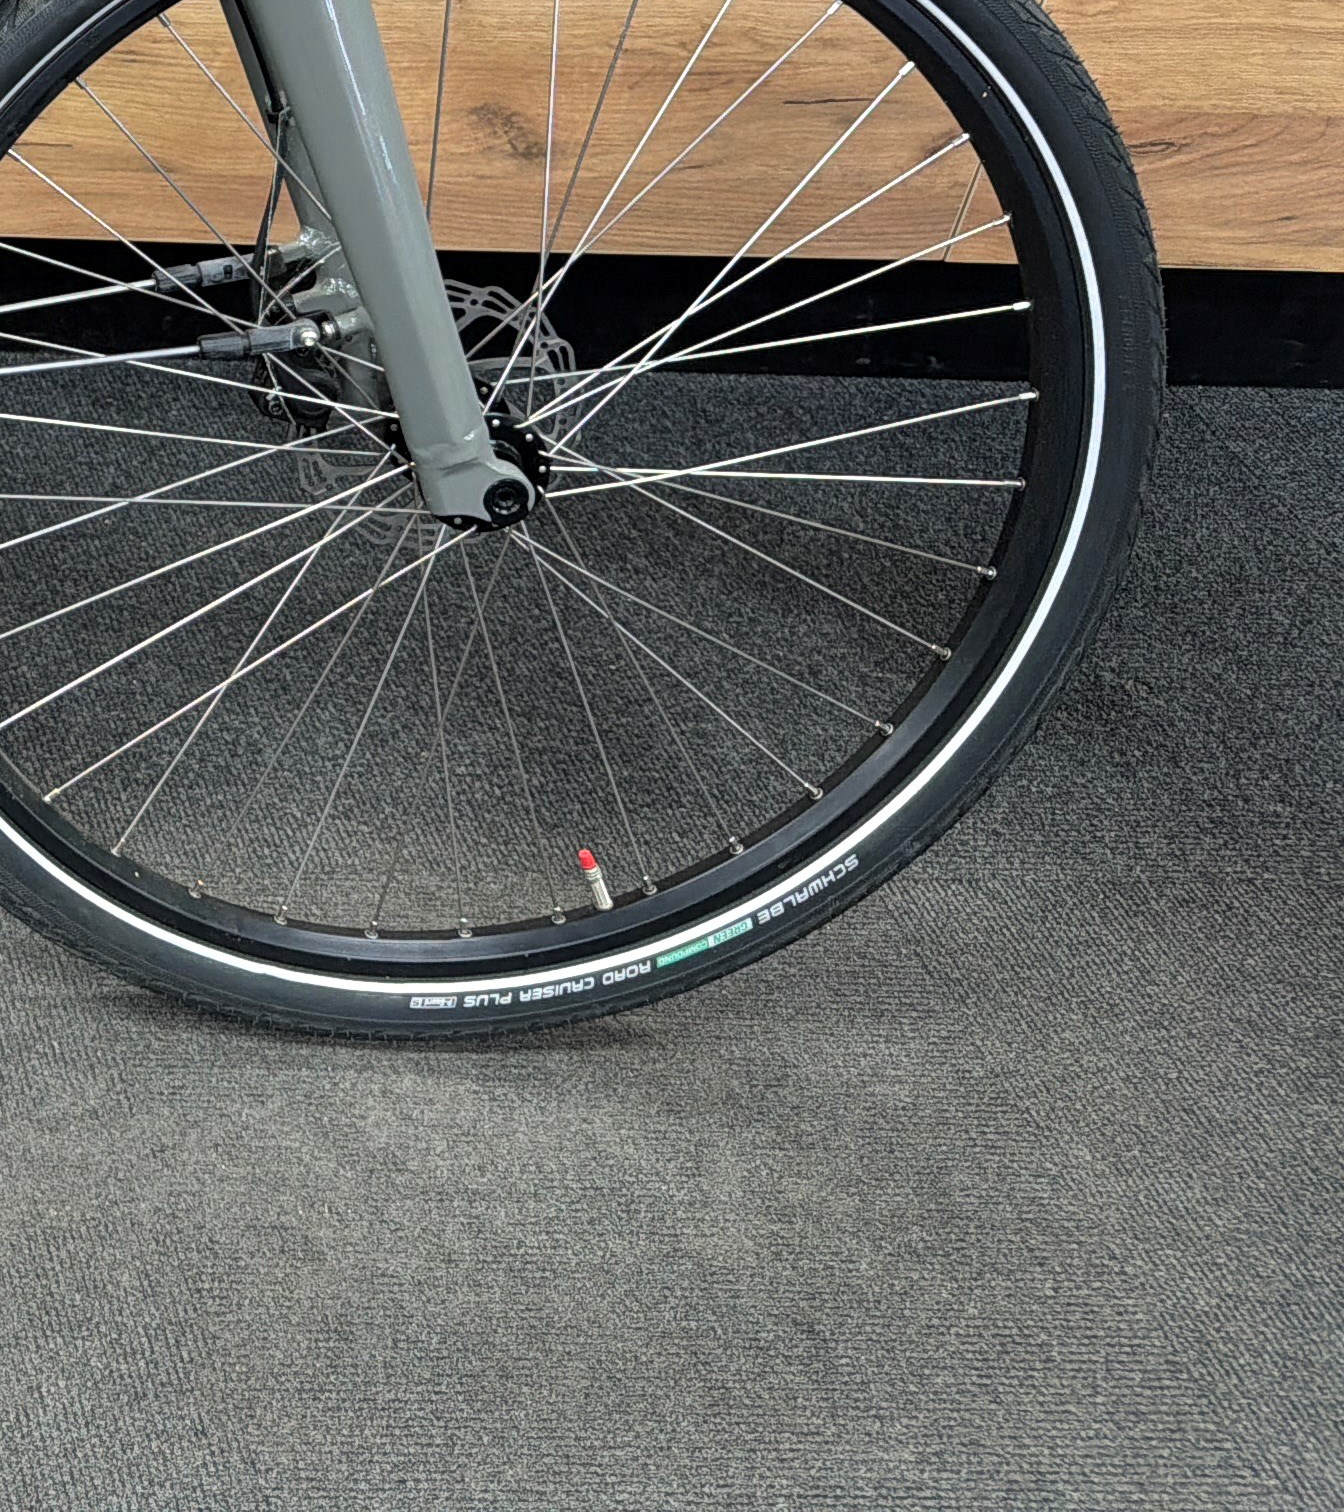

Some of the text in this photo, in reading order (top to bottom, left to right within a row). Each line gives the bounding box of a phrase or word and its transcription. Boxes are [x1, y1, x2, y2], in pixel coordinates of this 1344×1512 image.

[758, 853, 859, 925] SCHWALBE
[713, 921, 748, 944] GREEN
[659, 940, 707, 964] COMPOUND
[602, 959, 652, 986] ROAD
[463, 992, 512, 1008] PLUS
[519, 977, 595, 1002] CRUISER
